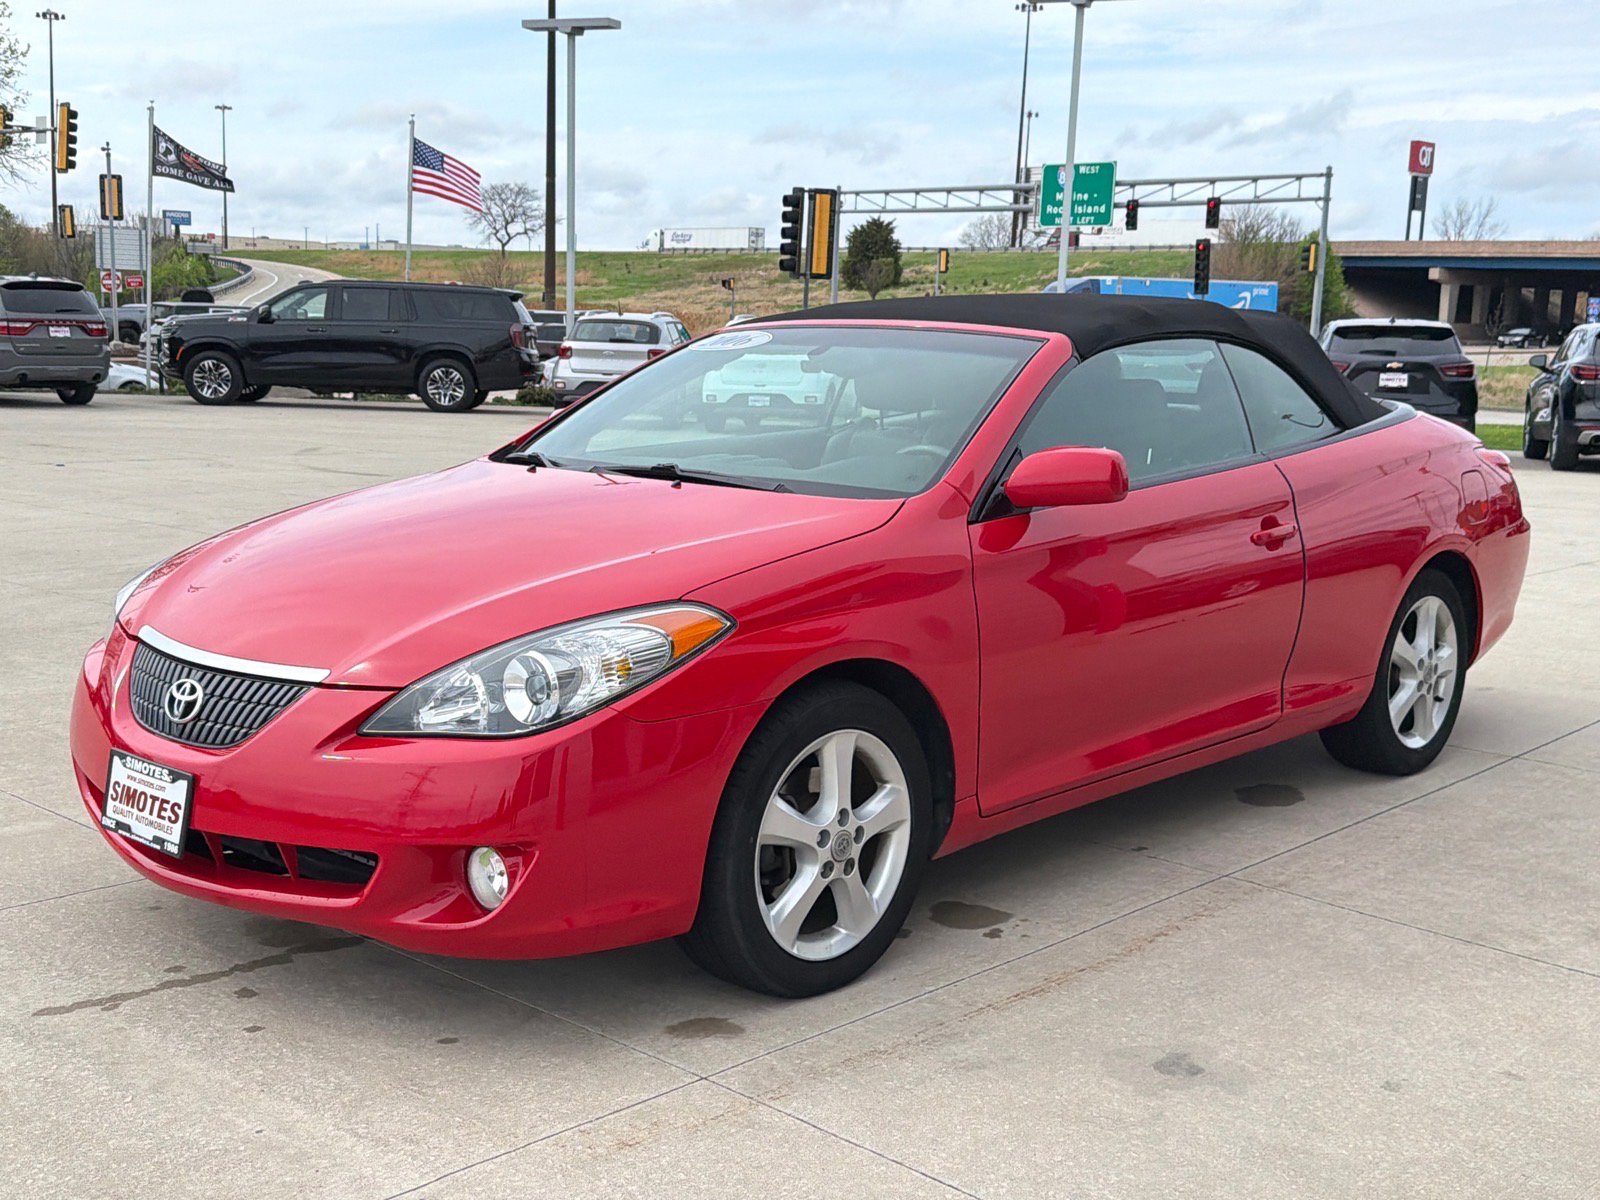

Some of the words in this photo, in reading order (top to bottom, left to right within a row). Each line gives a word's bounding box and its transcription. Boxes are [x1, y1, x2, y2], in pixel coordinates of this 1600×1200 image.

[1419, 145, 1433, 168] QT
[155, 165, 185, 178] SOME
[186, 171, 211, 186] GAVE
[212, 179, 232, 189] ALL
[1079, 165, 1100, 175] WEST
[1055, 191, 1089, 201] Mine
[1046, 204, 1066, 214] Roc
[1074, 203, 1106, 214] Island
[1076, 216, 1095, 225] LEFT
[125, 756, 170, 782] SIMOTES
[126, 773, 167, 794] www.simotes.com
[110, 780, 182, 825] SIMOTES
[112, 804, 135, 819] QUALITY
[134, 814, 174, 836] AUTOMOBILES
